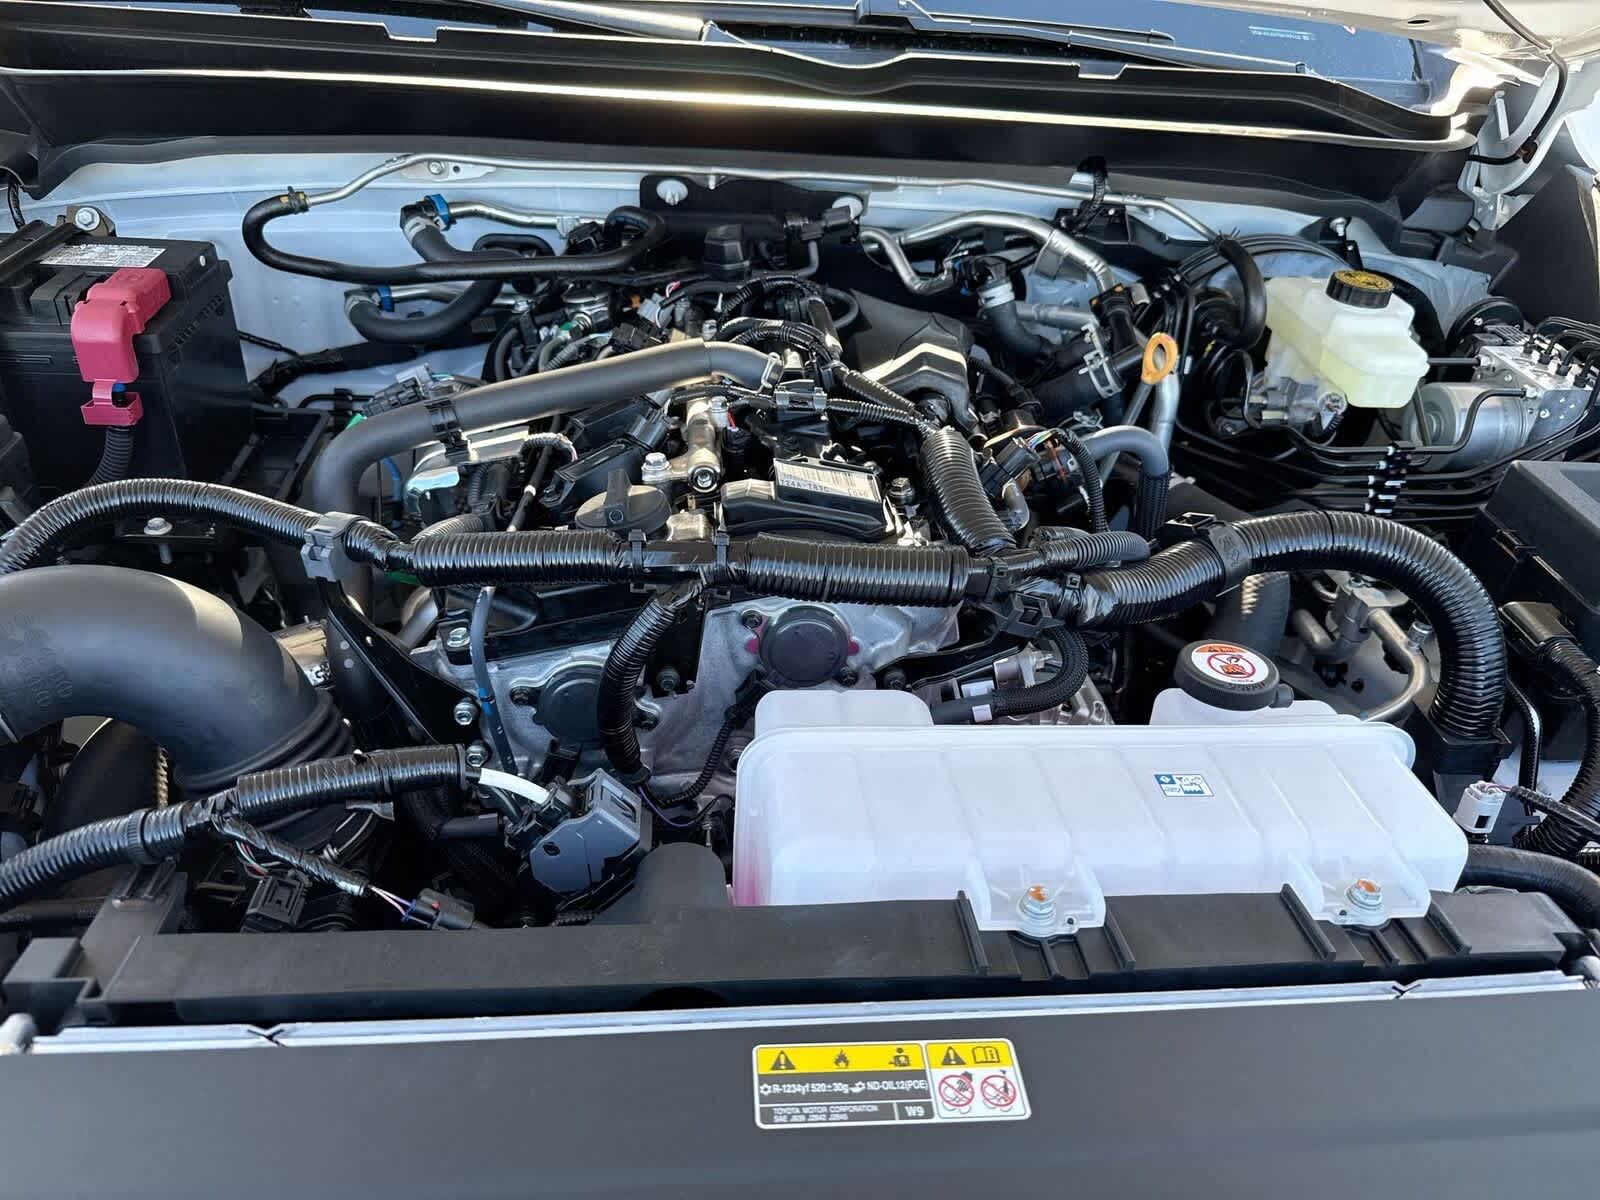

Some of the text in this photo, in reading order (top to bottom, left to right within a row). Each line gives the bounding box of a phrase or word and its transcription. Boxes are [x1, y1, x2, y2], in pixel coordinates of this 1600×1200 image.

[772, 1105, 879, 1115] TOYOTA MOTOR CORPORATION
[905, 1105, 925, 1117] W9
